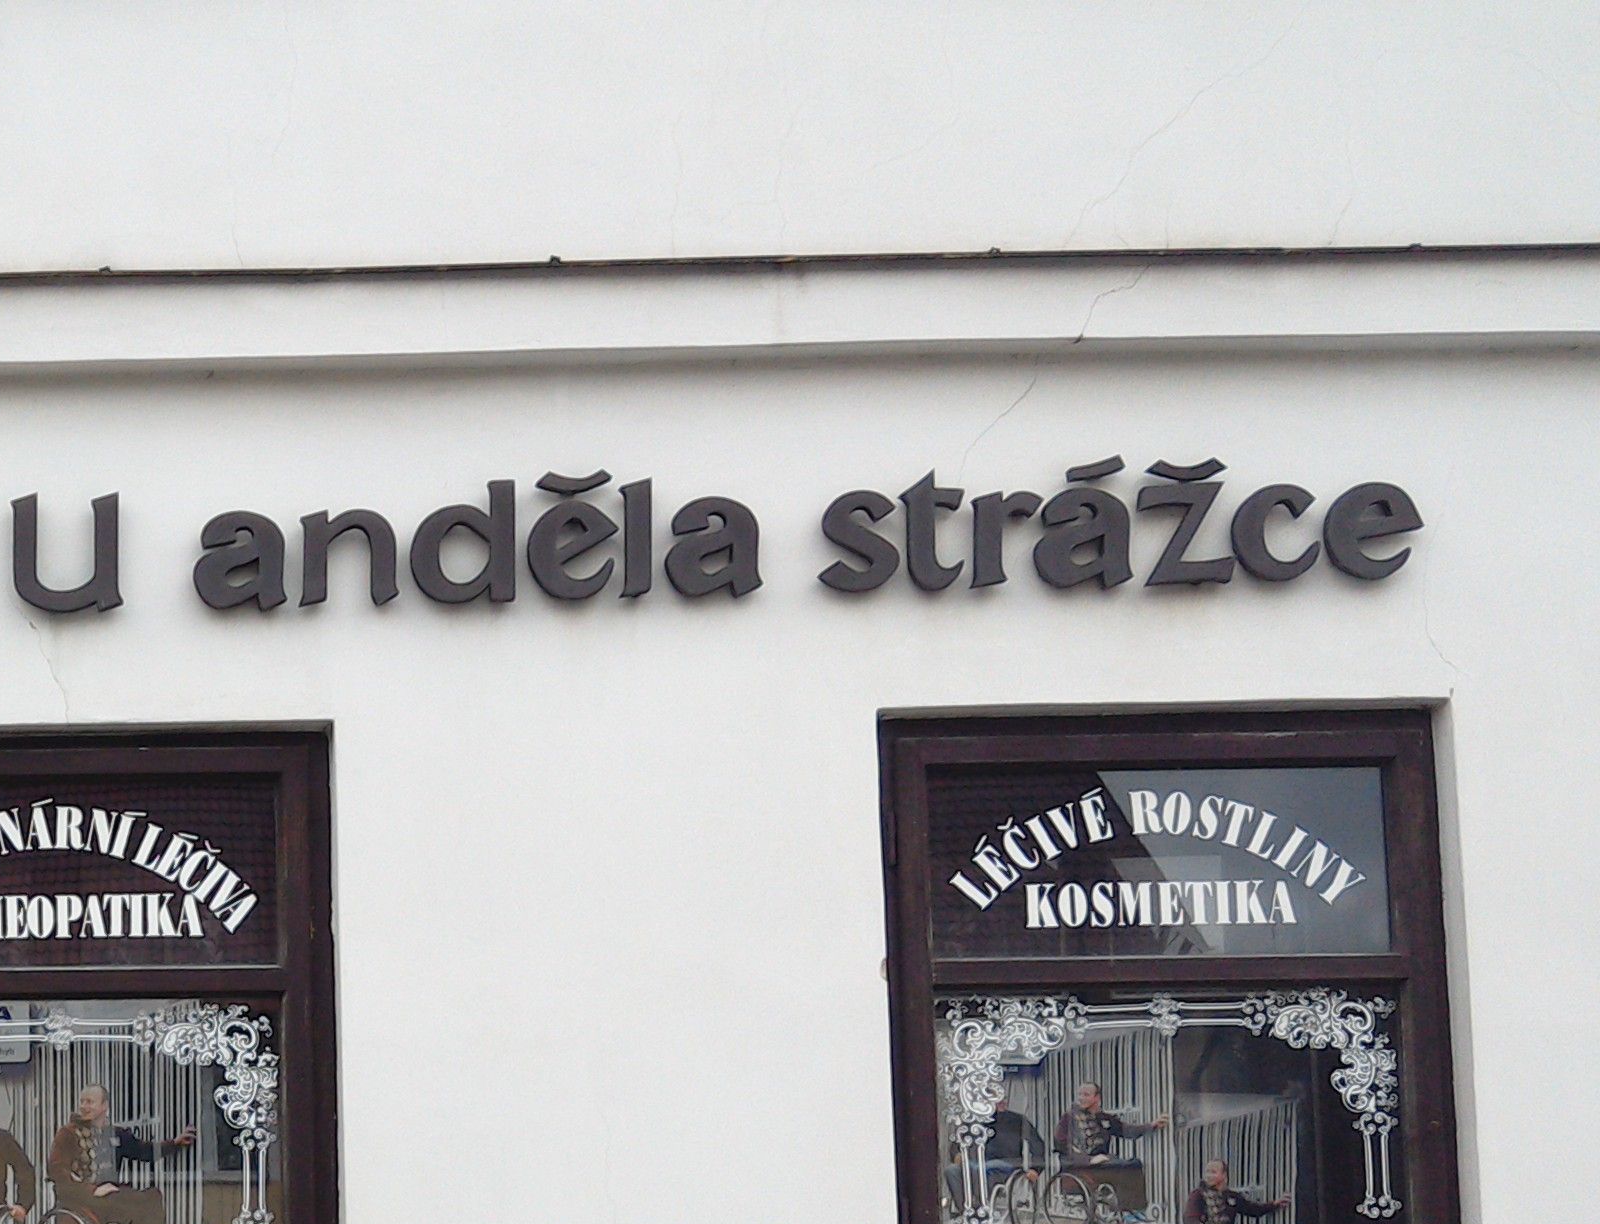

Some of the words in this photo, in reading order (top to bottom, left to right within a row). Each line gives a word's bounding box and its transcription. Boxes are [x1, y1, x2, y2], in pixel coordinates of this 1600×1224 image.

[11, 493, 124, 622] U
[192, 470, 763, 618] anděla
[817, 455, 1424, 600] strážce
[131, 822, 260, 934] LÉČIVA
[949, 787, 1115, 910] LÉČIVÉ
[1128, 788, 1367, 907] ROSTLINY
[1025, 880, 1297, 930] KOSMETIKA
